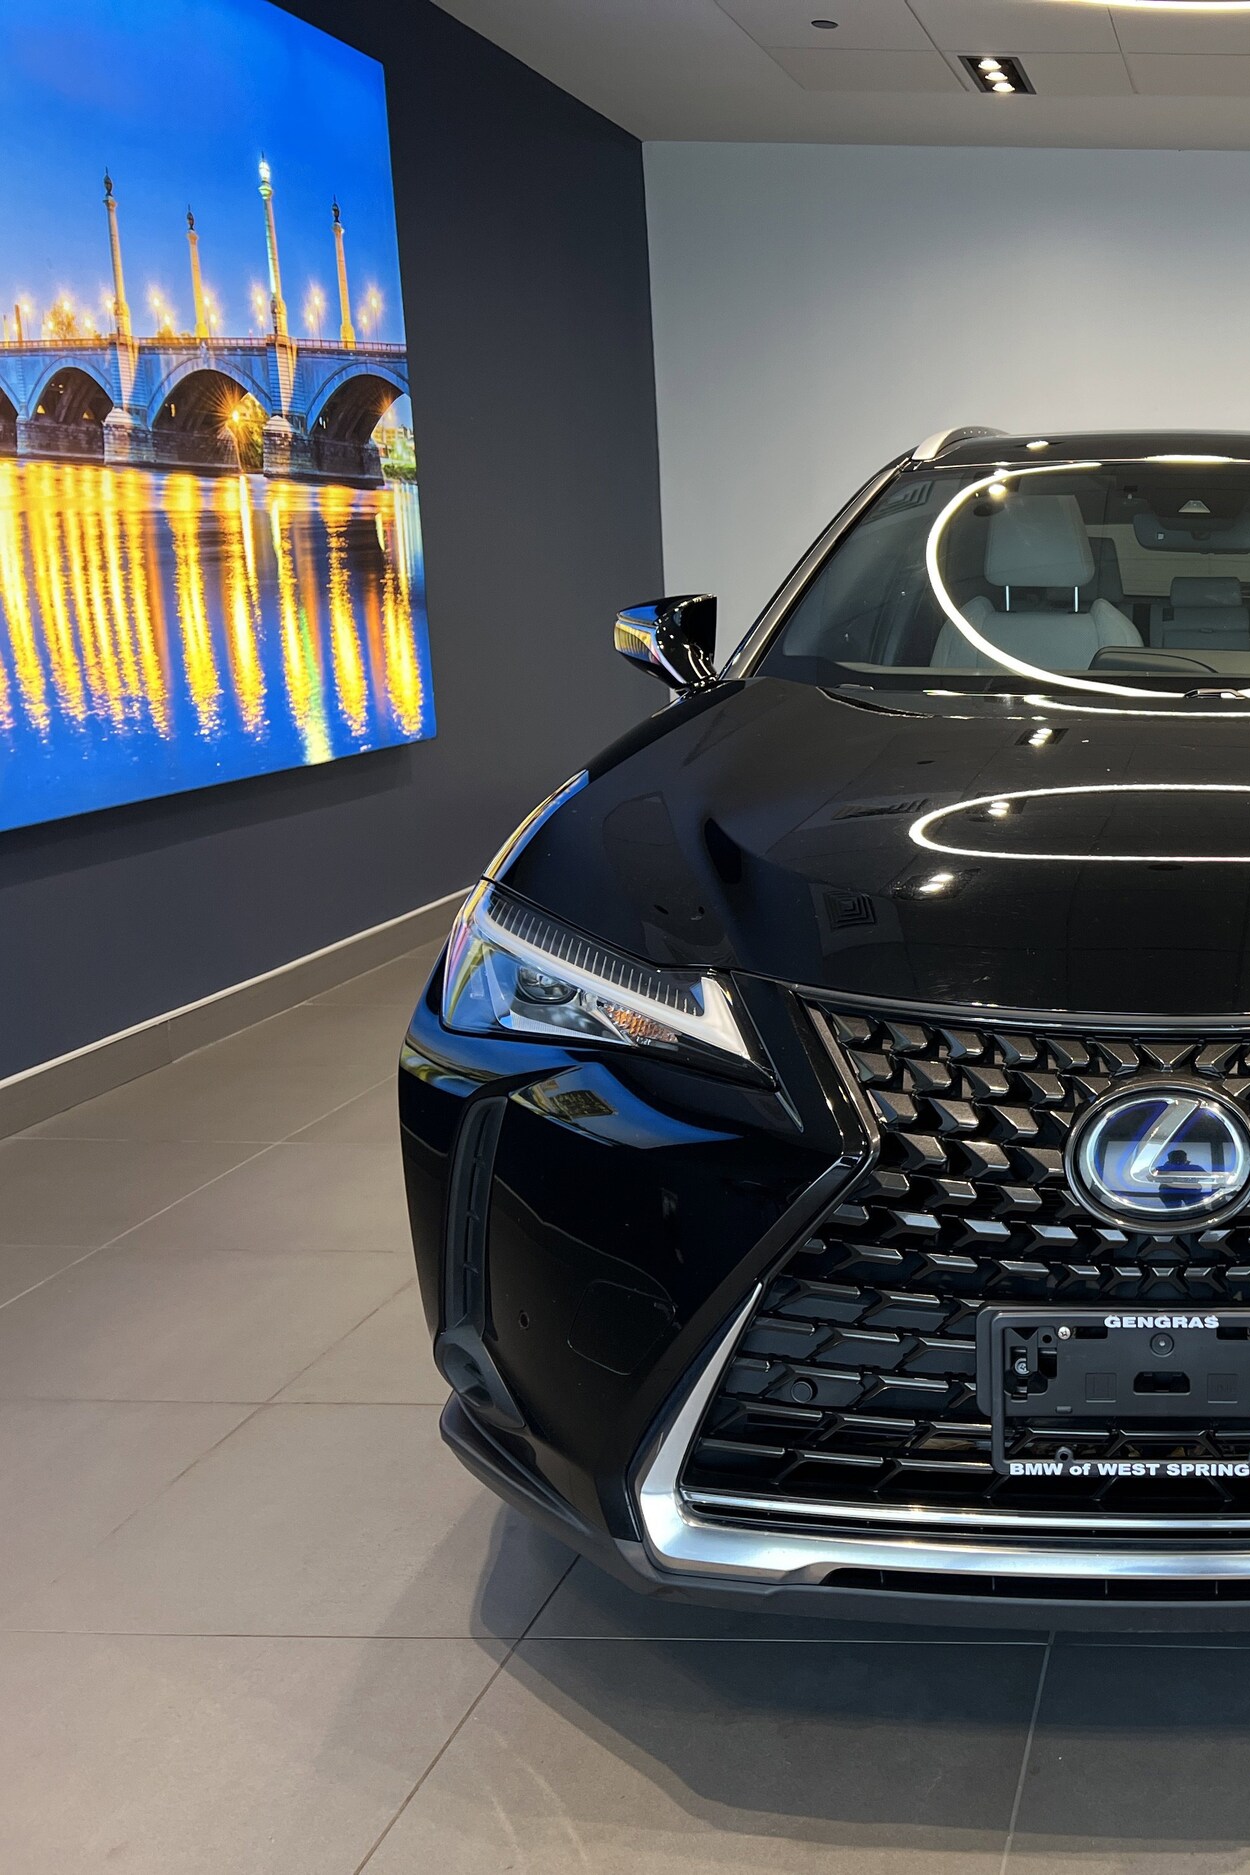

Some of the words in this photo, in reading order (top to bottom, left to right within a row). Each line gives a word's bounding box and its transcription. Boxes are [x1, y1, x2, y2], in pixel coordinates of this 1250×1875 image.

[1104, 1315, 1220, 1328] GENGRAS
[1009, 1462, 1063, 1476] BMW
[1069, 1463, 1091, 1476] of
[1097, 1463, 1160, 1476] WEST
